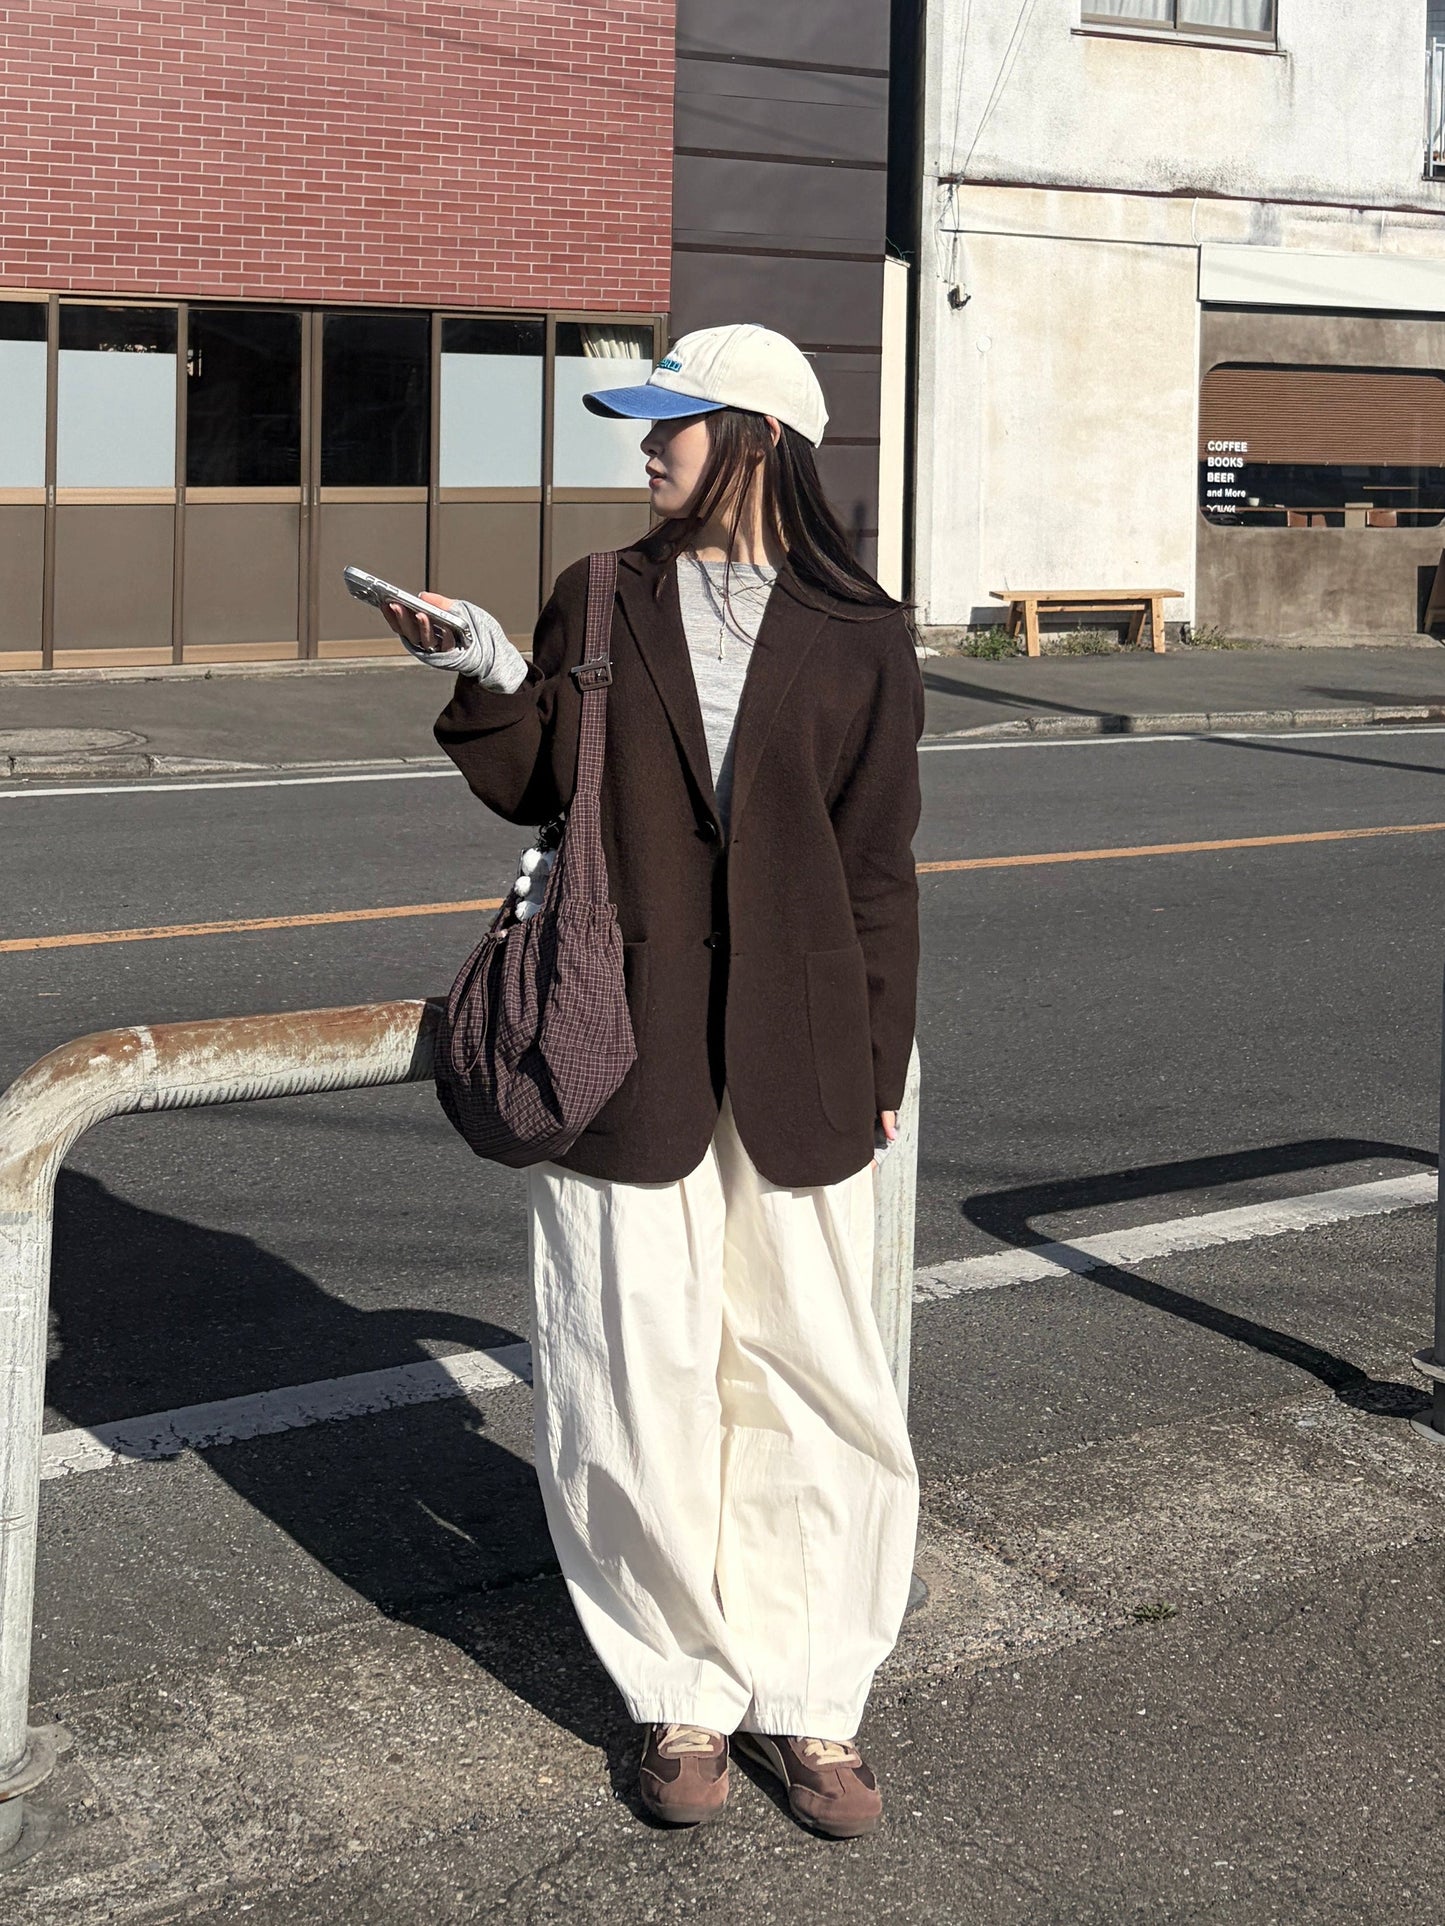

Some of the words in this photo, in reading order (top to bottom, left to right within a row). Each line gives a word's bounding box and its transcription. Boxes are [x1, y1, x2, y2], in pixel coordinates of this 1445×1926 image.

[1207, 441, 1248, 452] COFFEE
[1207, 457, 1243, 468] BOOKS
[1207, 472, 1235, 483] BEER
[1206, 488, 1222, 498] and
[1224, 488, 1246, 498] More
